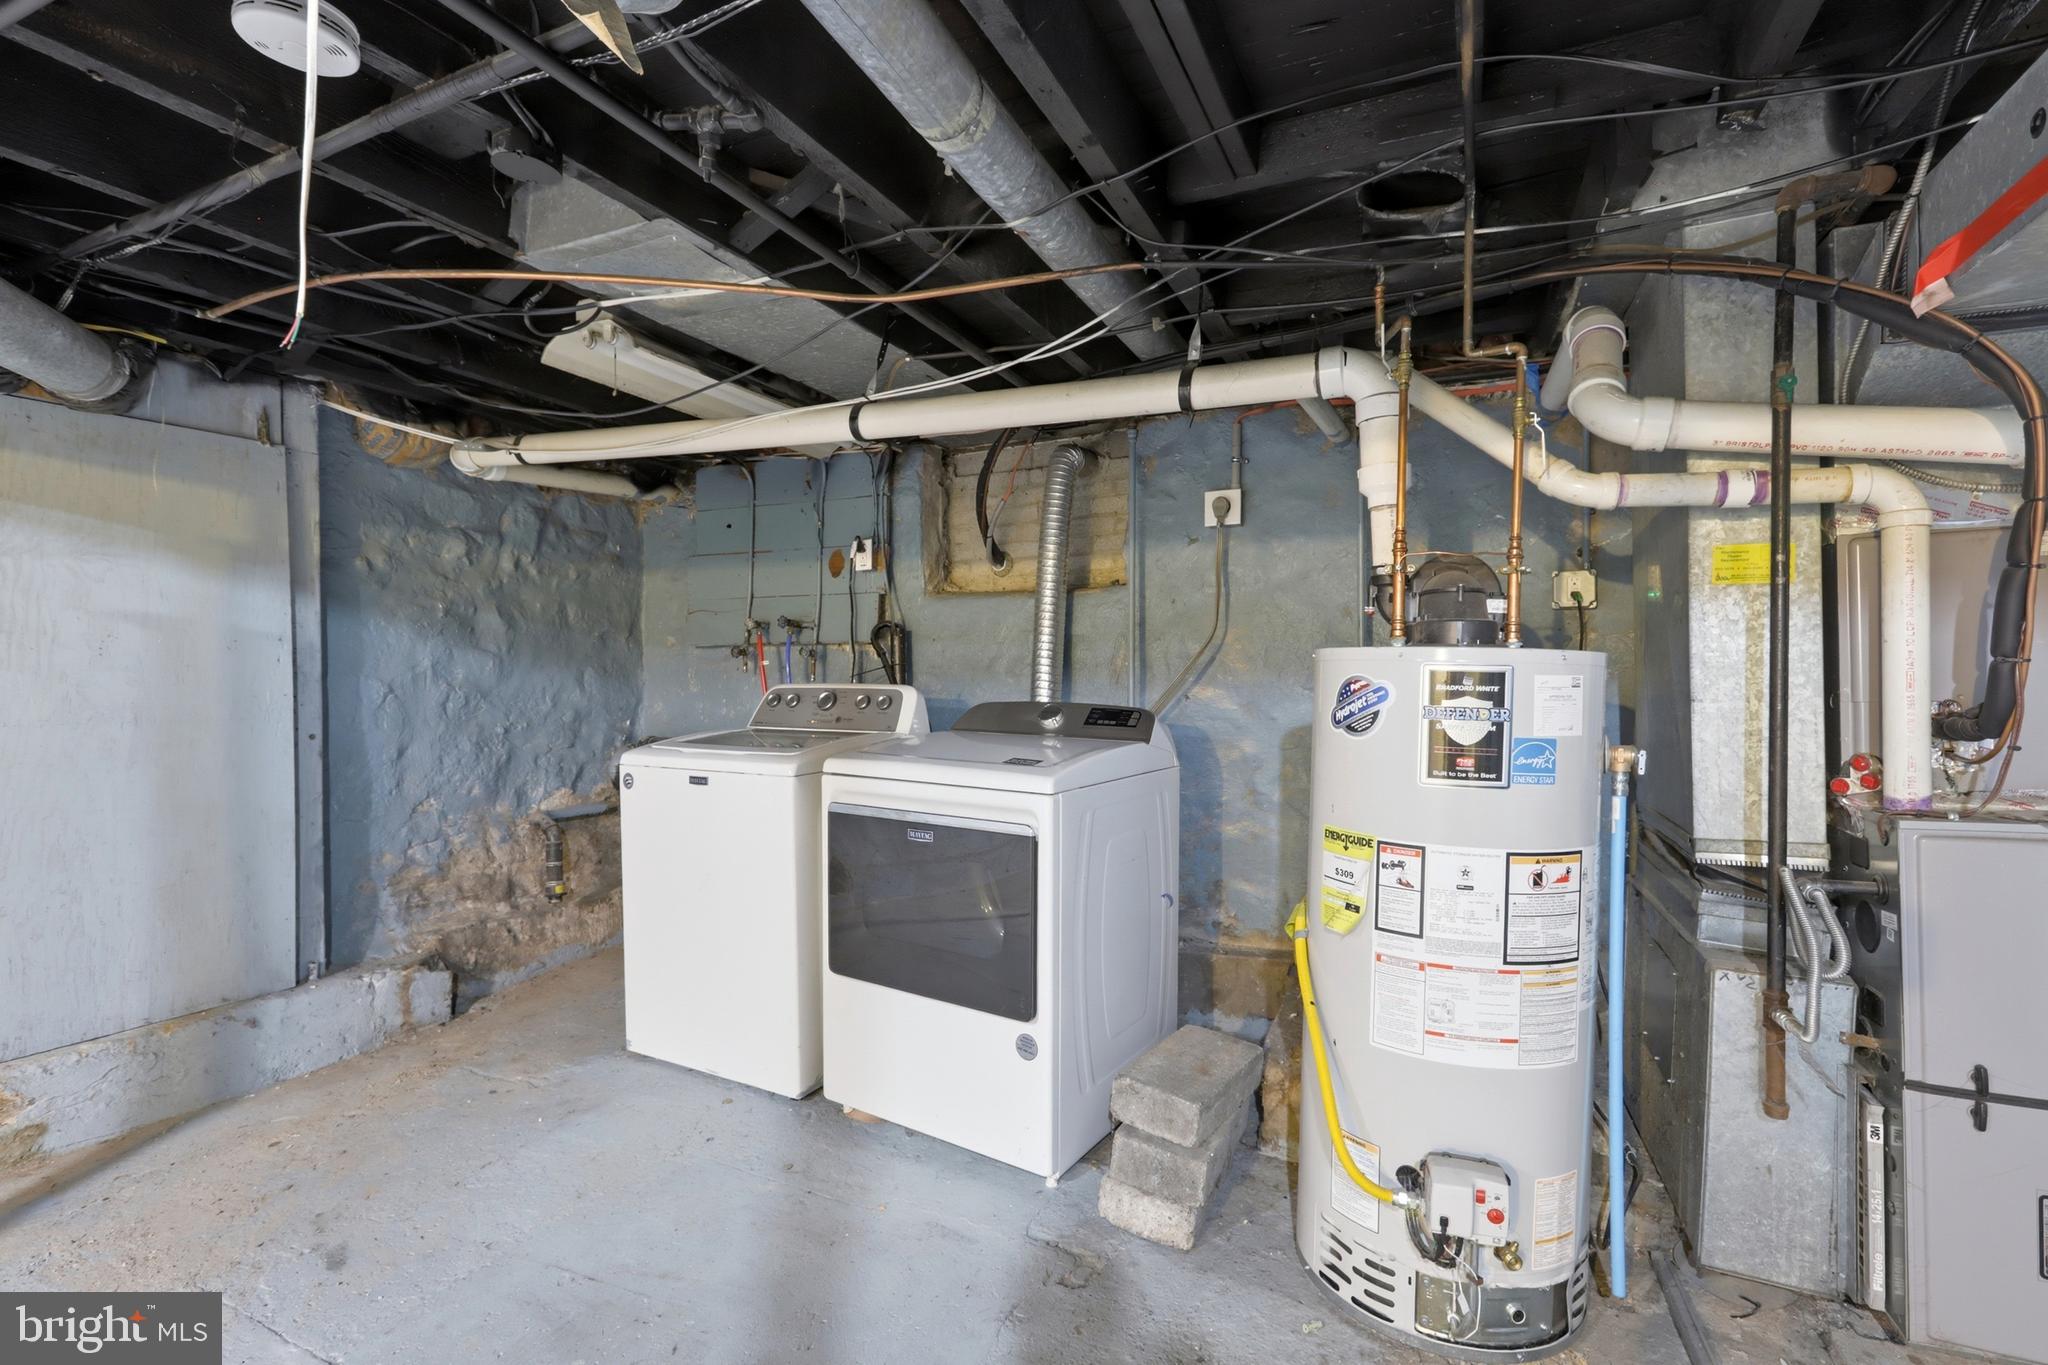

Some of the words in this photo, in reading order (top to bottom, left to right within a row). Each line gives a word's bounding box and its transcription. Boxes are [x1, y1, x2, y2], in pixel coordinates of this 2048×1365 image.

[1475, 685, 1501, 693] WHITE
[1335, 695, 1368, 722] Hydrojet
[1423, 705, 1511, 722] DEFENDER
[1513, 776, 1539, 784] ENERGY
[1335, 867, 1354, 880] $309
[1870, 1124, 1881, 1141] 3M
